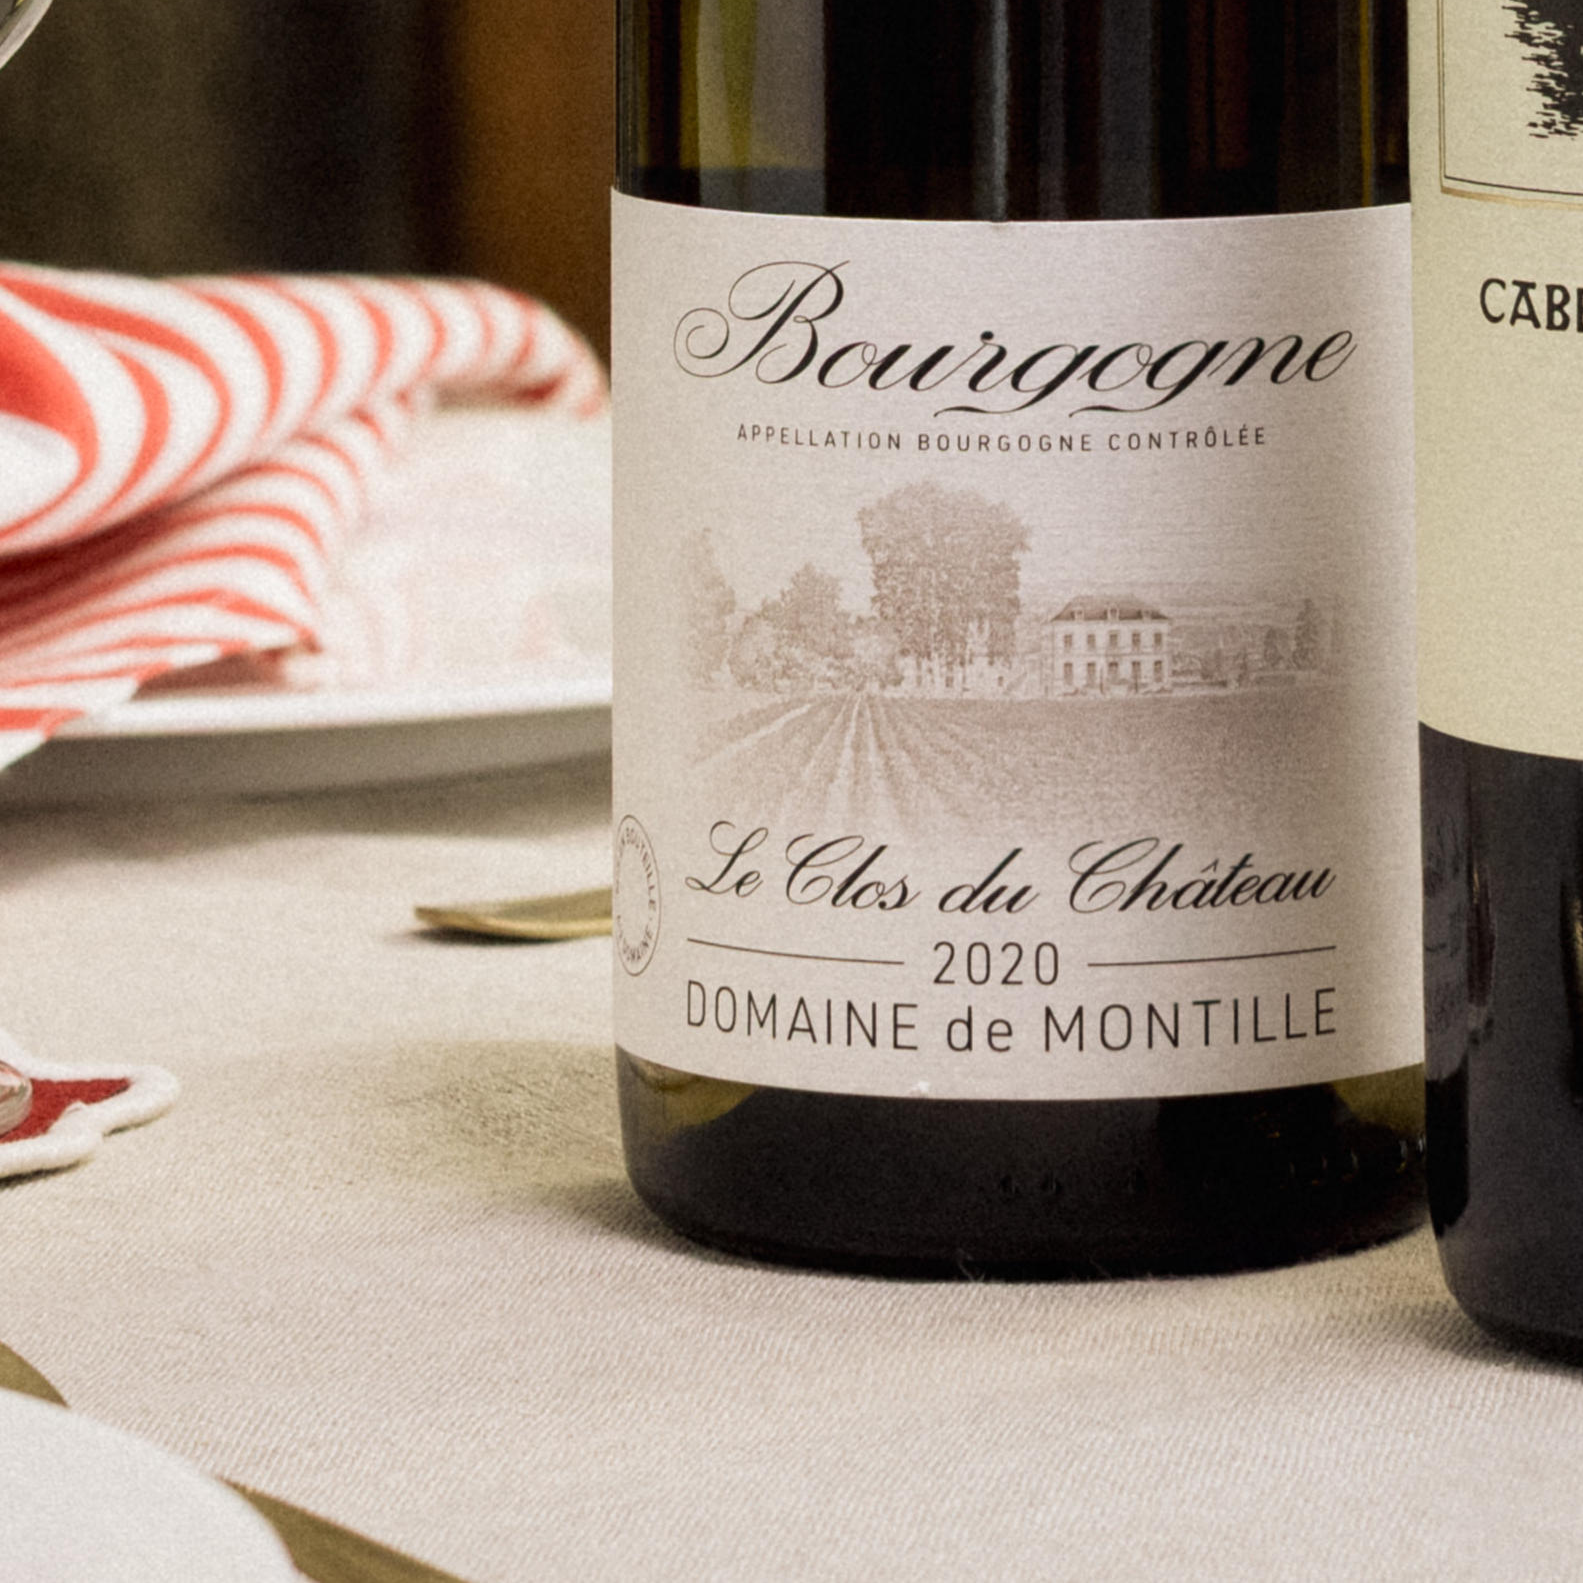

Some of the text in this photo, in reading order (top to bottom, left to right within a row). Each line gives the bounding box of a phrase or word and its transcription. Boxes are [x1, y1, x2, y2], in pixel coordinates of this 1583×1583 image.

[673, 260, 1358, 418] Bourgogne
[737, 422, 1267, 453] APPELLATION BOURGOGNE CONTRÔLÉE
[685, 820, 765, 899] Le
[785, 833, 921, 912] Clos
[938, 848, 1039, 914] du
[1068, 836, 1337, 914] Château
[932, 940, 1060, 986] 2020
[687, 979, 1339, 1054] DOMAINE de MONTILLE
